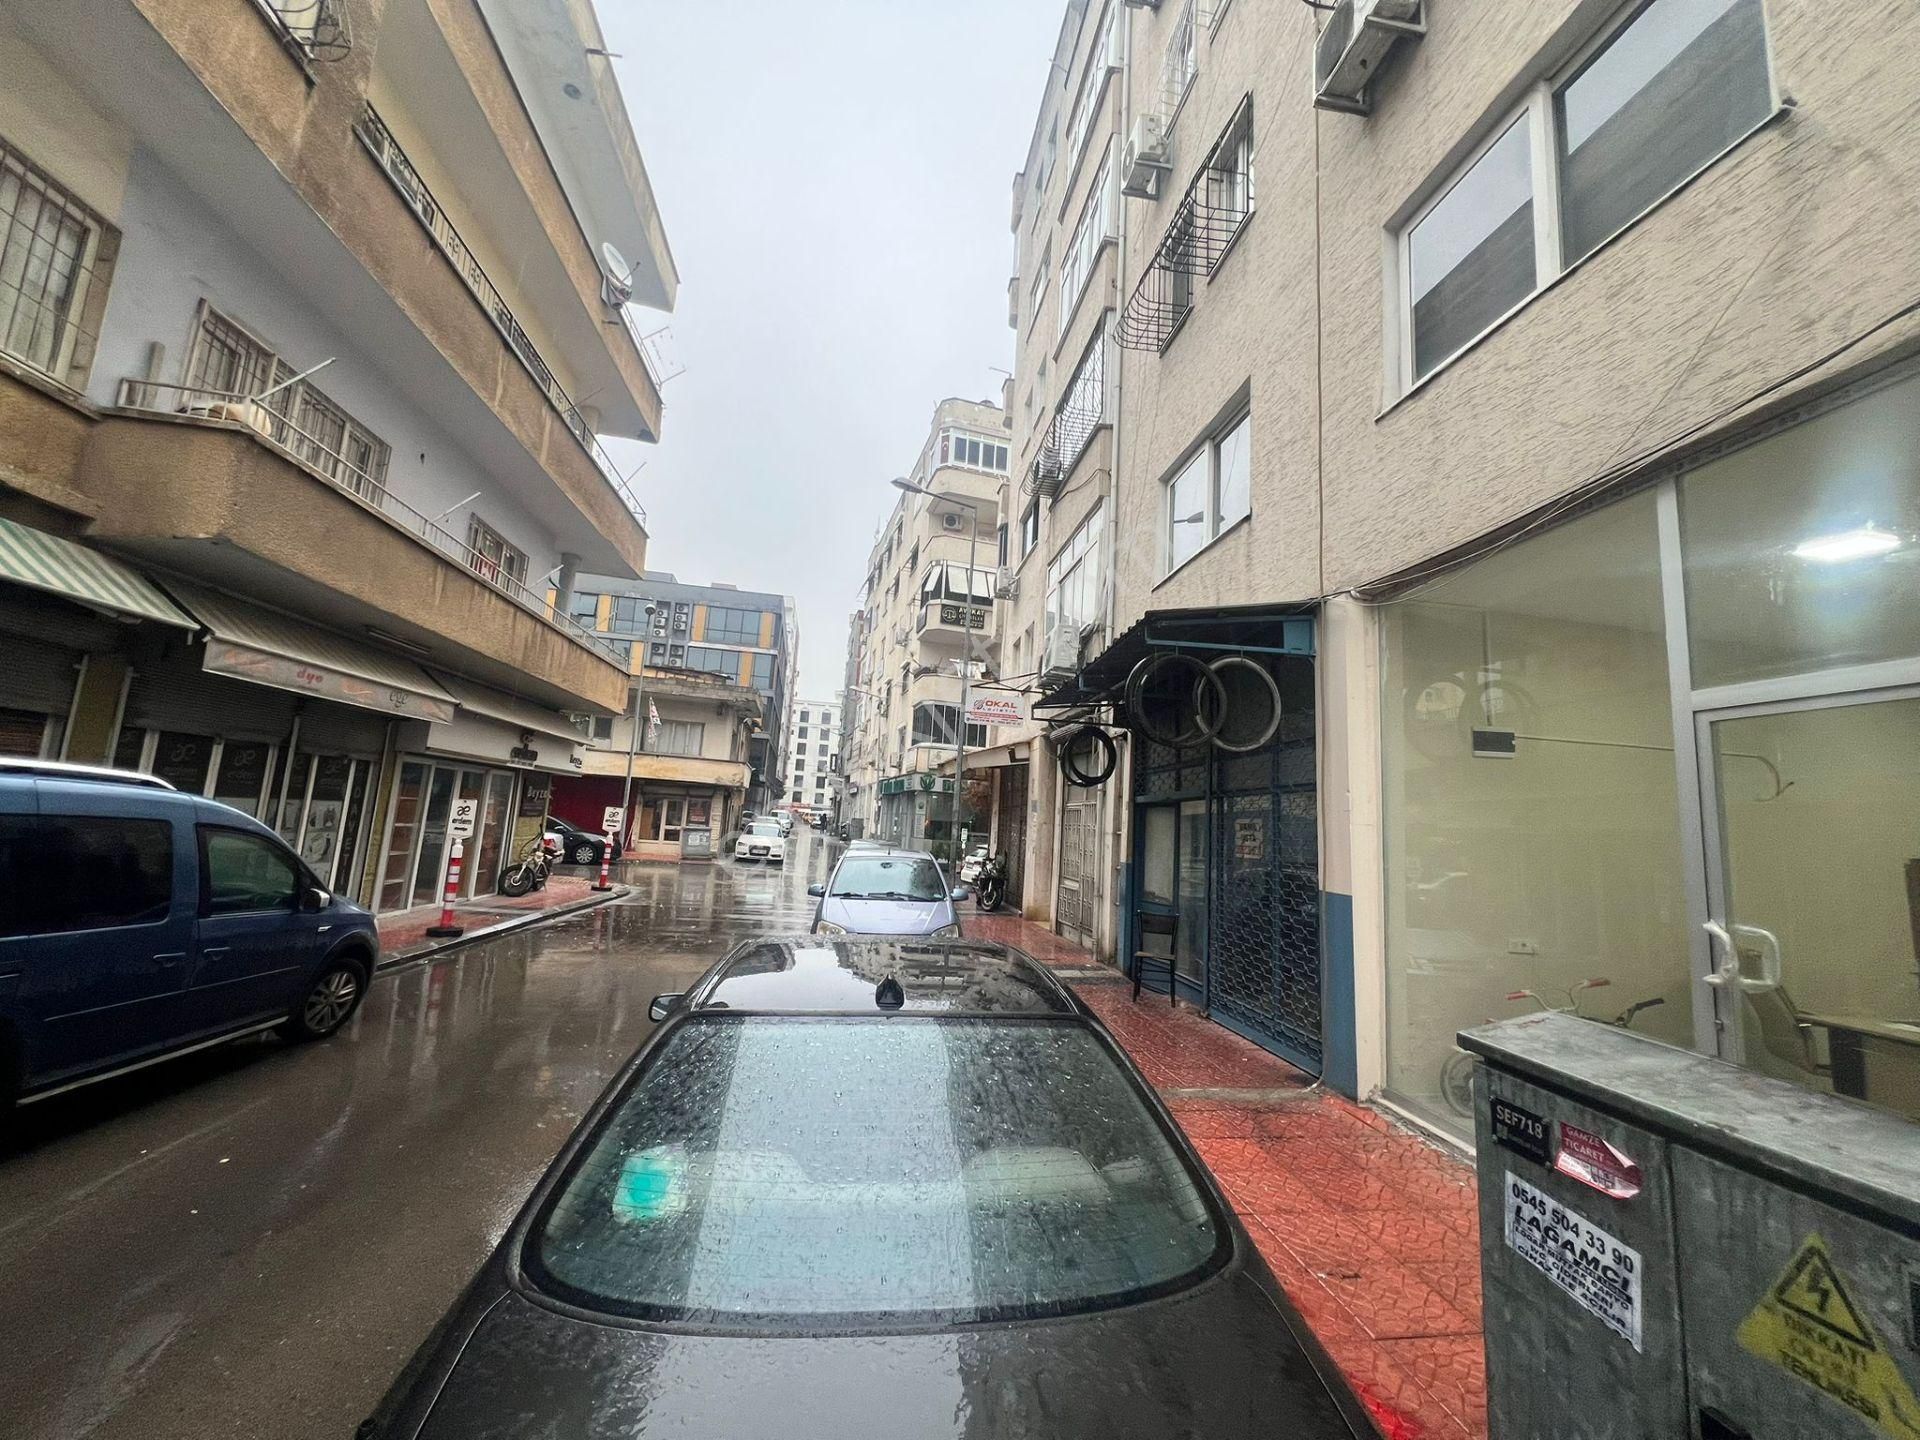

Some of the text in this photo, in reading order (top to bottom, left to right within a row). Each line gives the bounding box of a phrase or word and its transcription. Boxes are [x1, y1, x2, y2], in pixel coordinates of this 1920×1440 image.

[1496, 1105, 1543, 1139] SEF718
[1512, 1183, 1634, 1273] 0545 504 33 90
